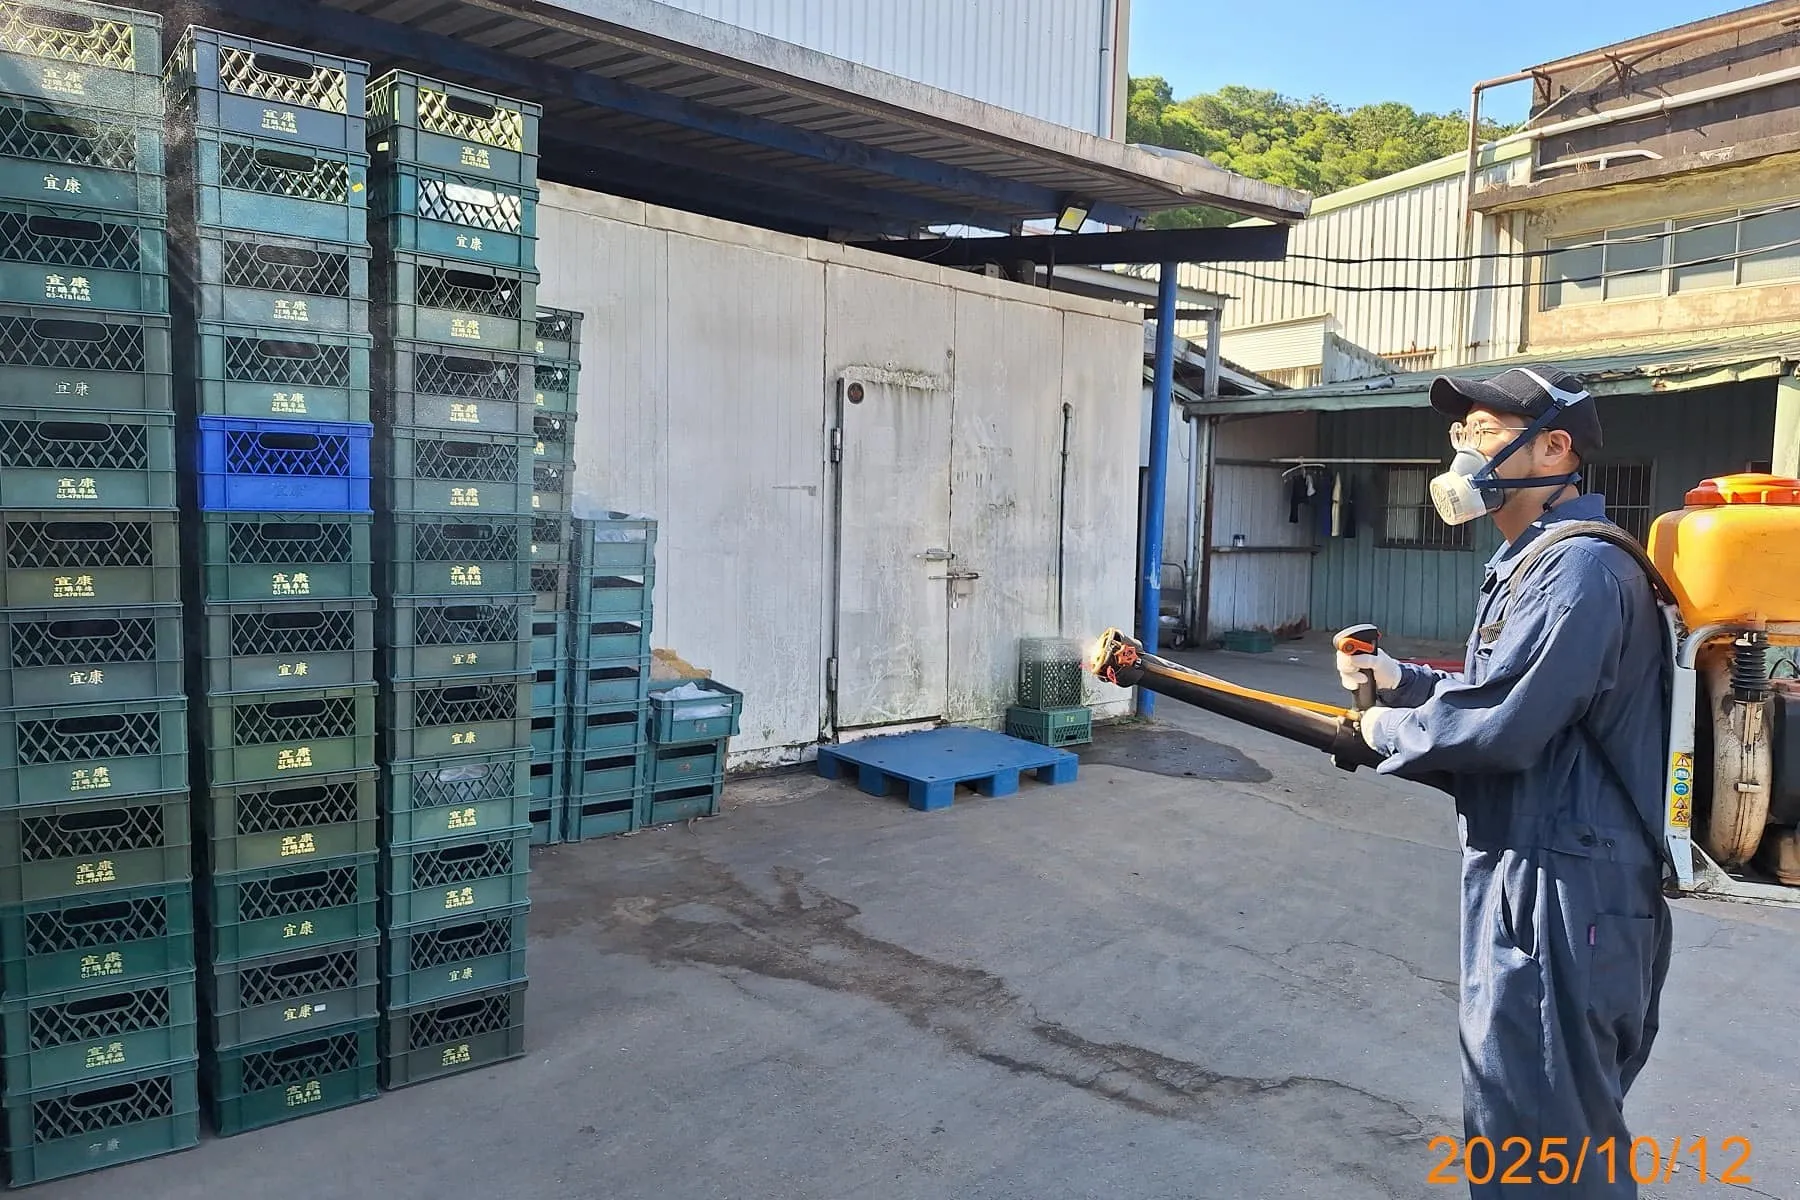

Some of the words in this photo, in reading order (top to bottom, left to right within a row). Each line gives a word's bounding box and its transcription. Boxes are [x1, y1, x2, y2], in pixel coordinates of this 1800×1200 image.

[262, 109, 297, 123] 宜康
[462, 146, 489, 159] 宜康
[44, 174, 82, 194] 宜康
[456, 234, 483, 251] 宜康
[46, 274, 91, 288] 宜康
[274, 299, 307, 311] 宜康
[55, 381, 90, 397] 宜康
[272, 392, 305, 403] 宜康
[58, 477, 96, 488] 宜康
[451, 488, 479, 496] 宜康
[451, 565, 482, 575] 宜康
[54, 575, 94, 585] 宜康
[273, 573, 309, 583] 宜康
[452, 653, 477, 665] 宜康
[278, 662, 309, 676] 宜康
[69, 669, 104, 685] 宜康
[451, 731, 476, 745] 宜康
[279, 747, 311, 759] 宜康
[72, 767, 110, 780] 宜康
[449, 808, 476, 819] 宜康
[281, 833, 314, 846] 宜康
[76, 860, 114, 874] 宜康
[446, 887, 473, 899] 宜康
[283, 920, 314, 938] 宜康
[81, 951, 123, 966] 宜康
[448, 967, 473, 982] 宜康
[284, 1004, 312, 1021] 宜康
[87, 1041, 124, 1057] 宜康
[287, 1081, 321, 1095] 宜康
